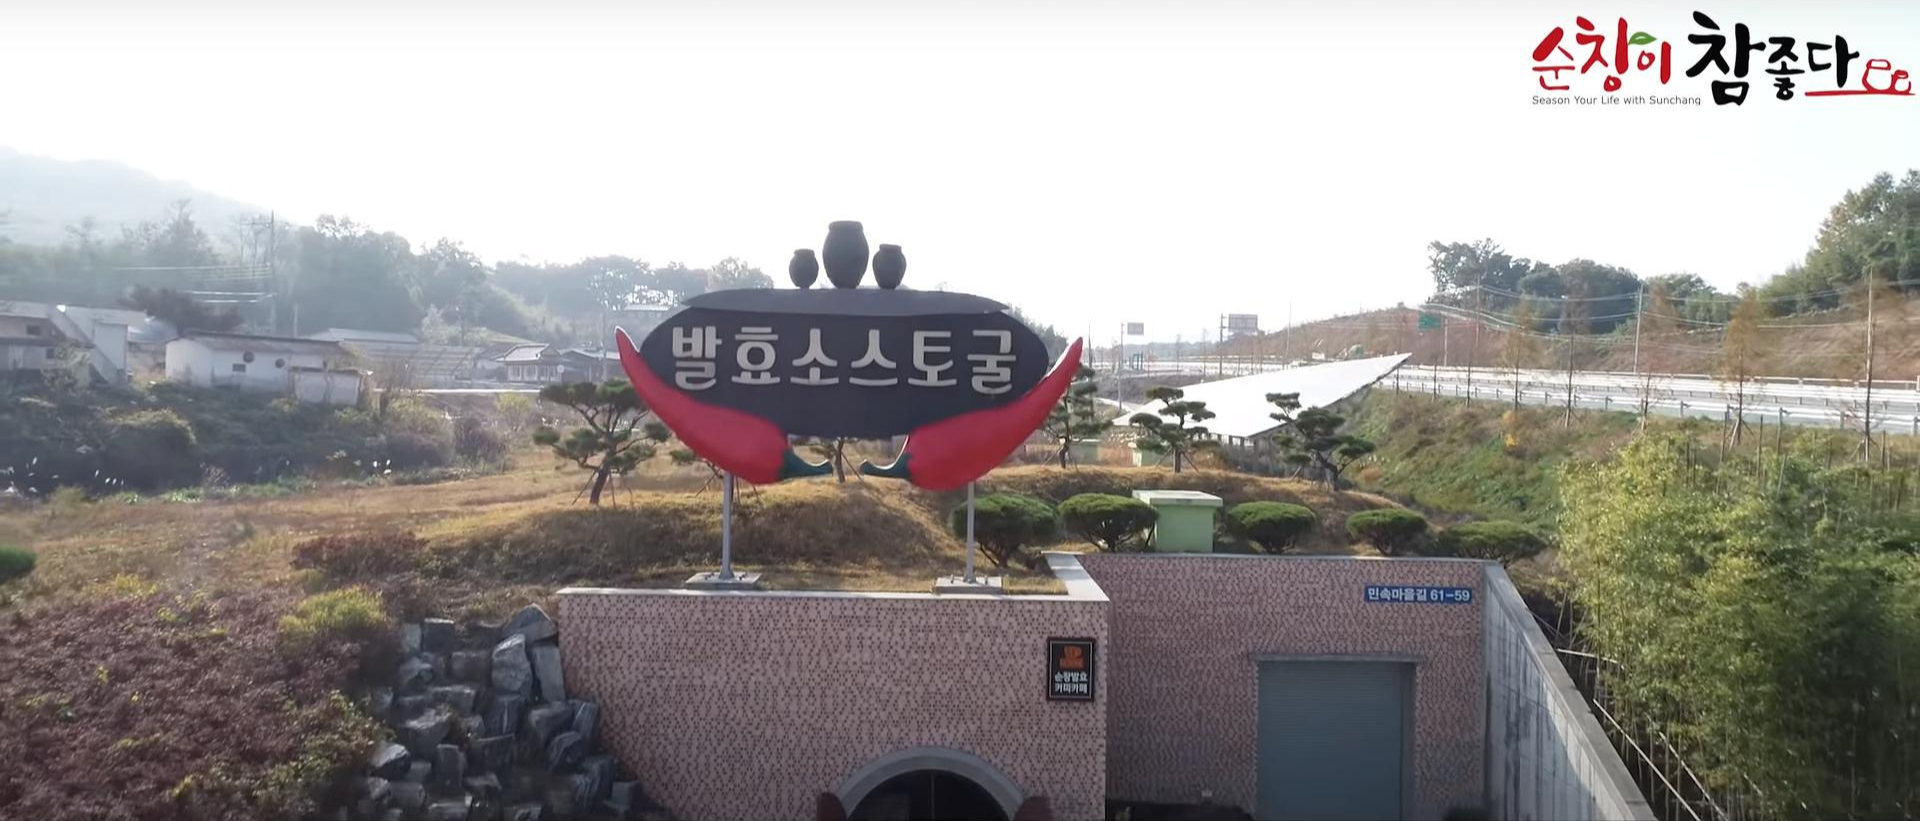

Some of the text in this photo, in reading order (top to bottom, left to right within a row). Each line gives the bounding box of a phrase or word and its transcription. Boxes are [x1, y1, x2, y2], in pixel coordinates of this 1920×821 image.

[672, 326, 1016, 393] 발효소스토굴
[1367, 587, 1471, 602] 민속마을길 61-59
